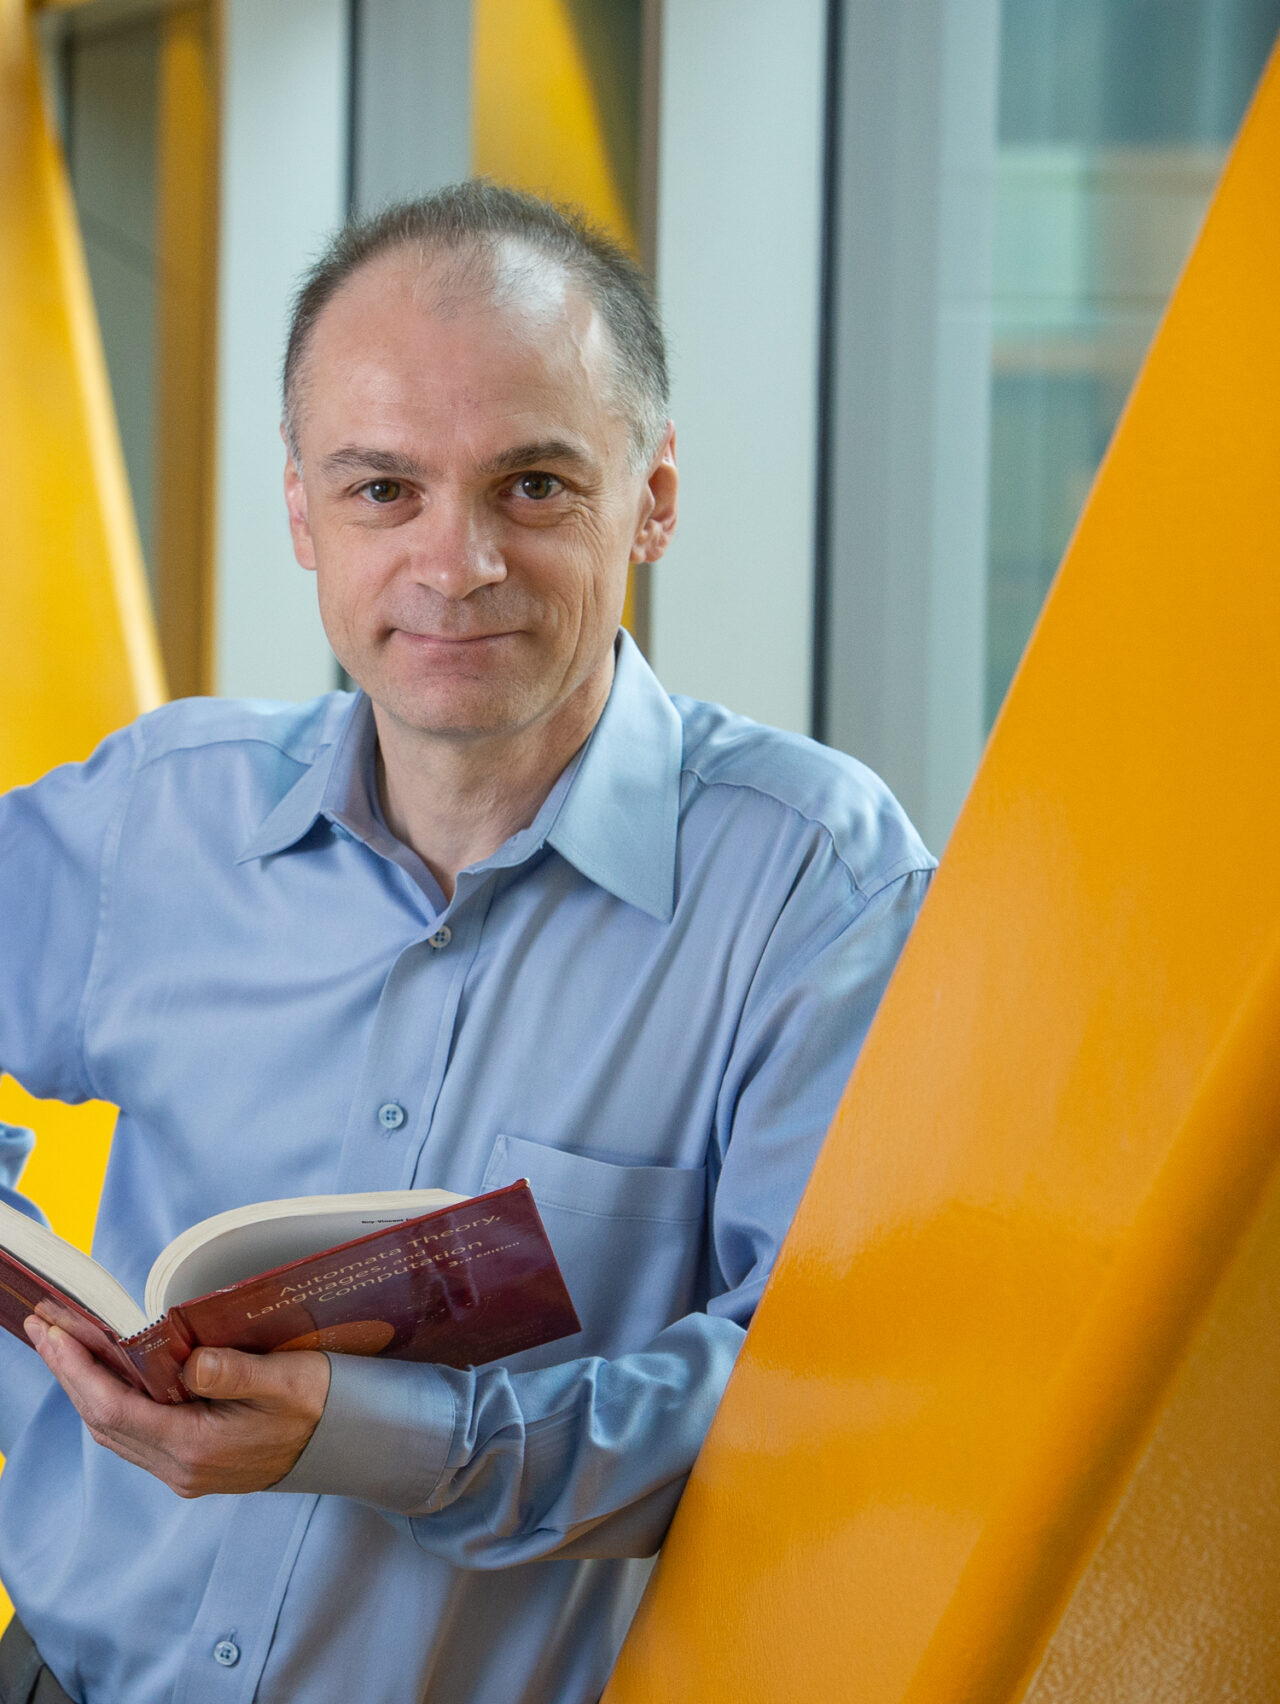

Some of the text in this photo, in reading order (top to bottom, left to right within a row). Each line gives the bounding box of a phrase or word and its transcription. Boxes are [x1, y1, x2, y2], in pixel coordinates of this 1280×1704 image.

[246, 1264, 387, 1320] Languages,
[392, 1249, 426, 1266] and
[280, 1215, 501, 1296] Automata Theory,
[318, 1240, 483, 1302] Computation
